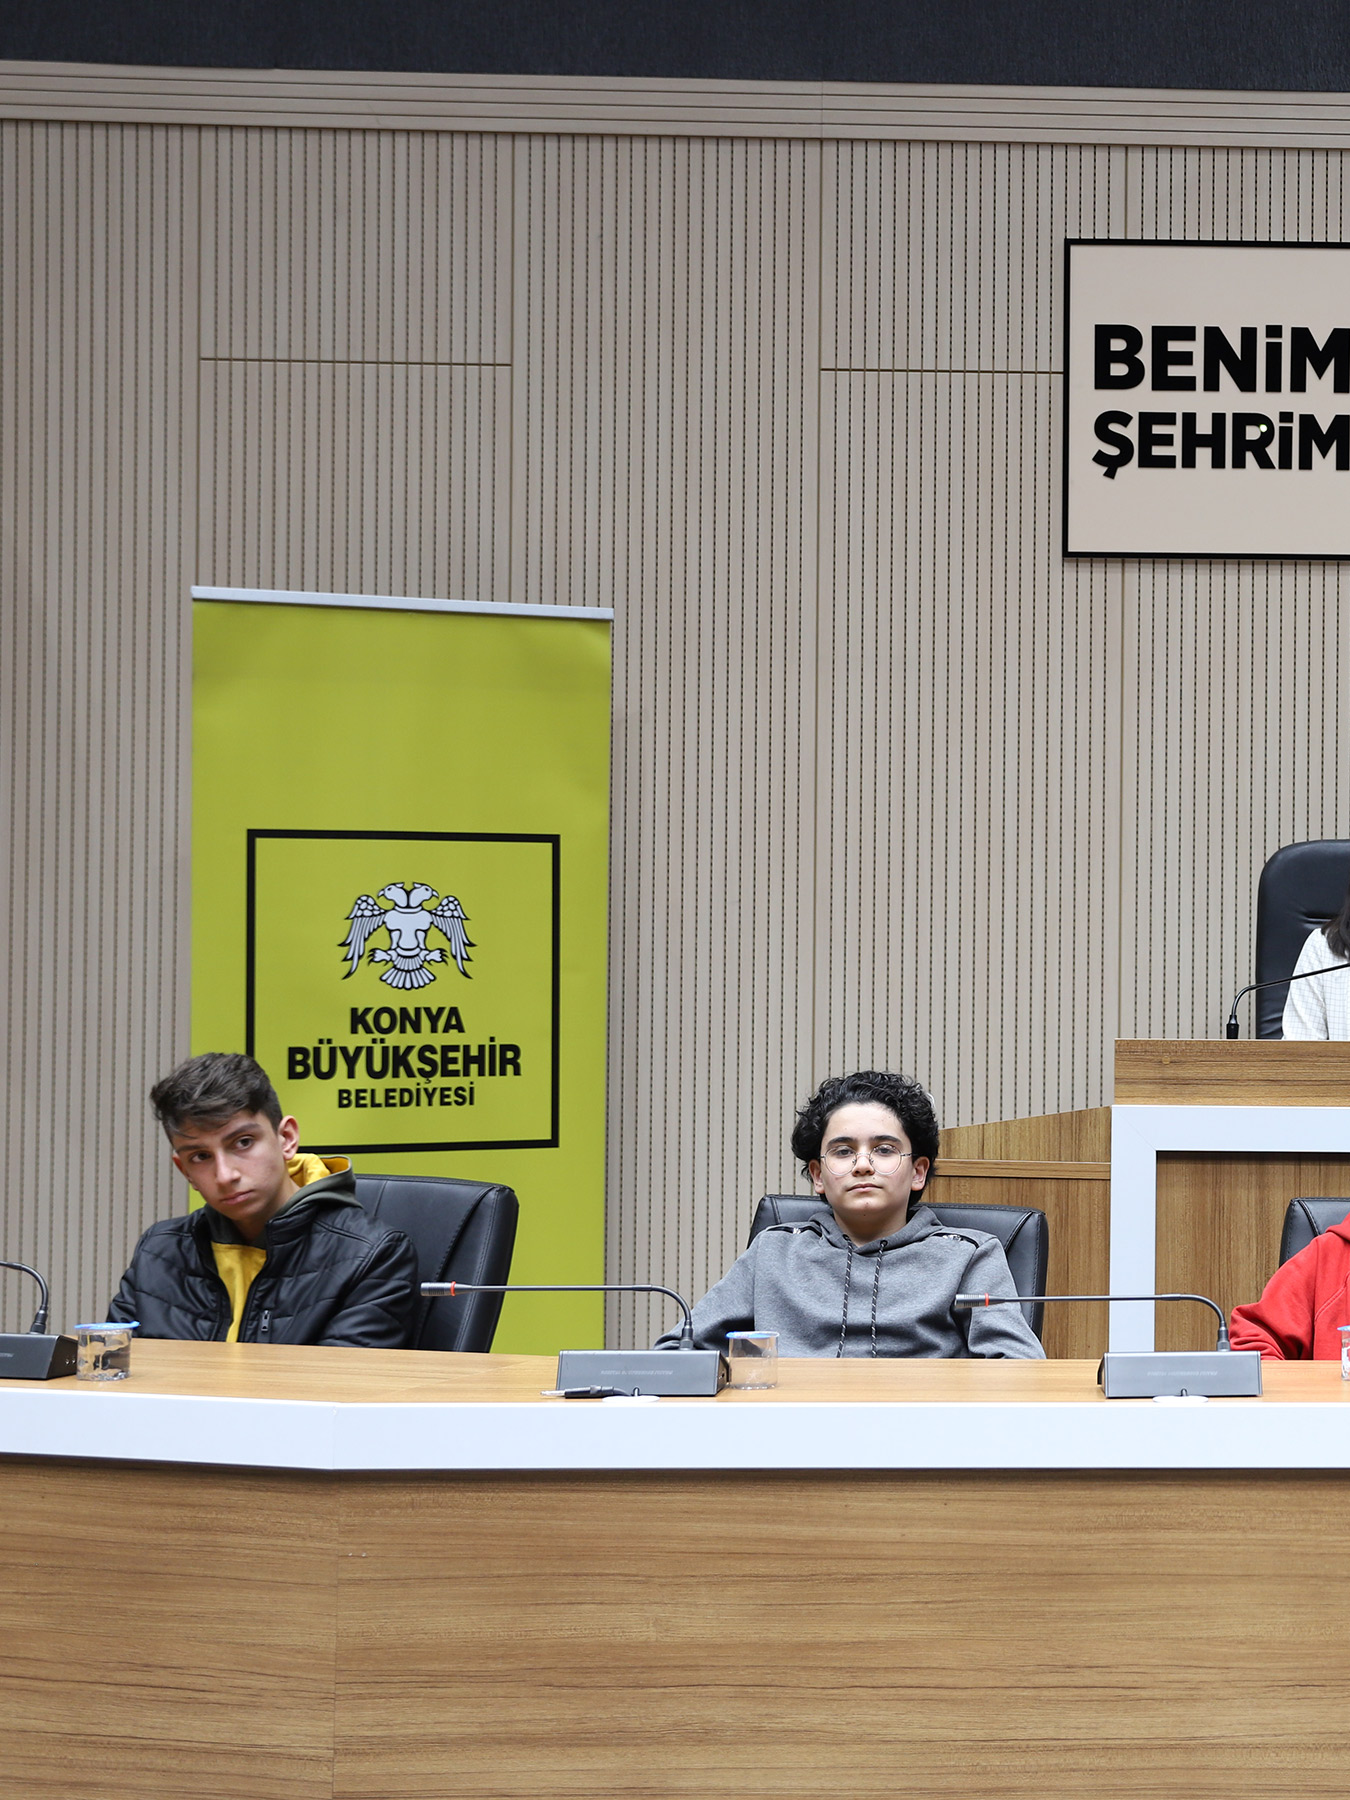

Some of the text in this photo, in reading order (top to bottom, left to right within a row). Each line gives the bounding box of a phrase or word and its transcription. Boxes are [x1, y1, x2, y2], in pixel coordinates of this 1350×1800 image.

[350, 1006, 466, 1035] KONYA
[287, 1036, 522, 1085] BÜYÜKŞEHİR
[337, 1081, 476, 1109] BELEDİYESİ
